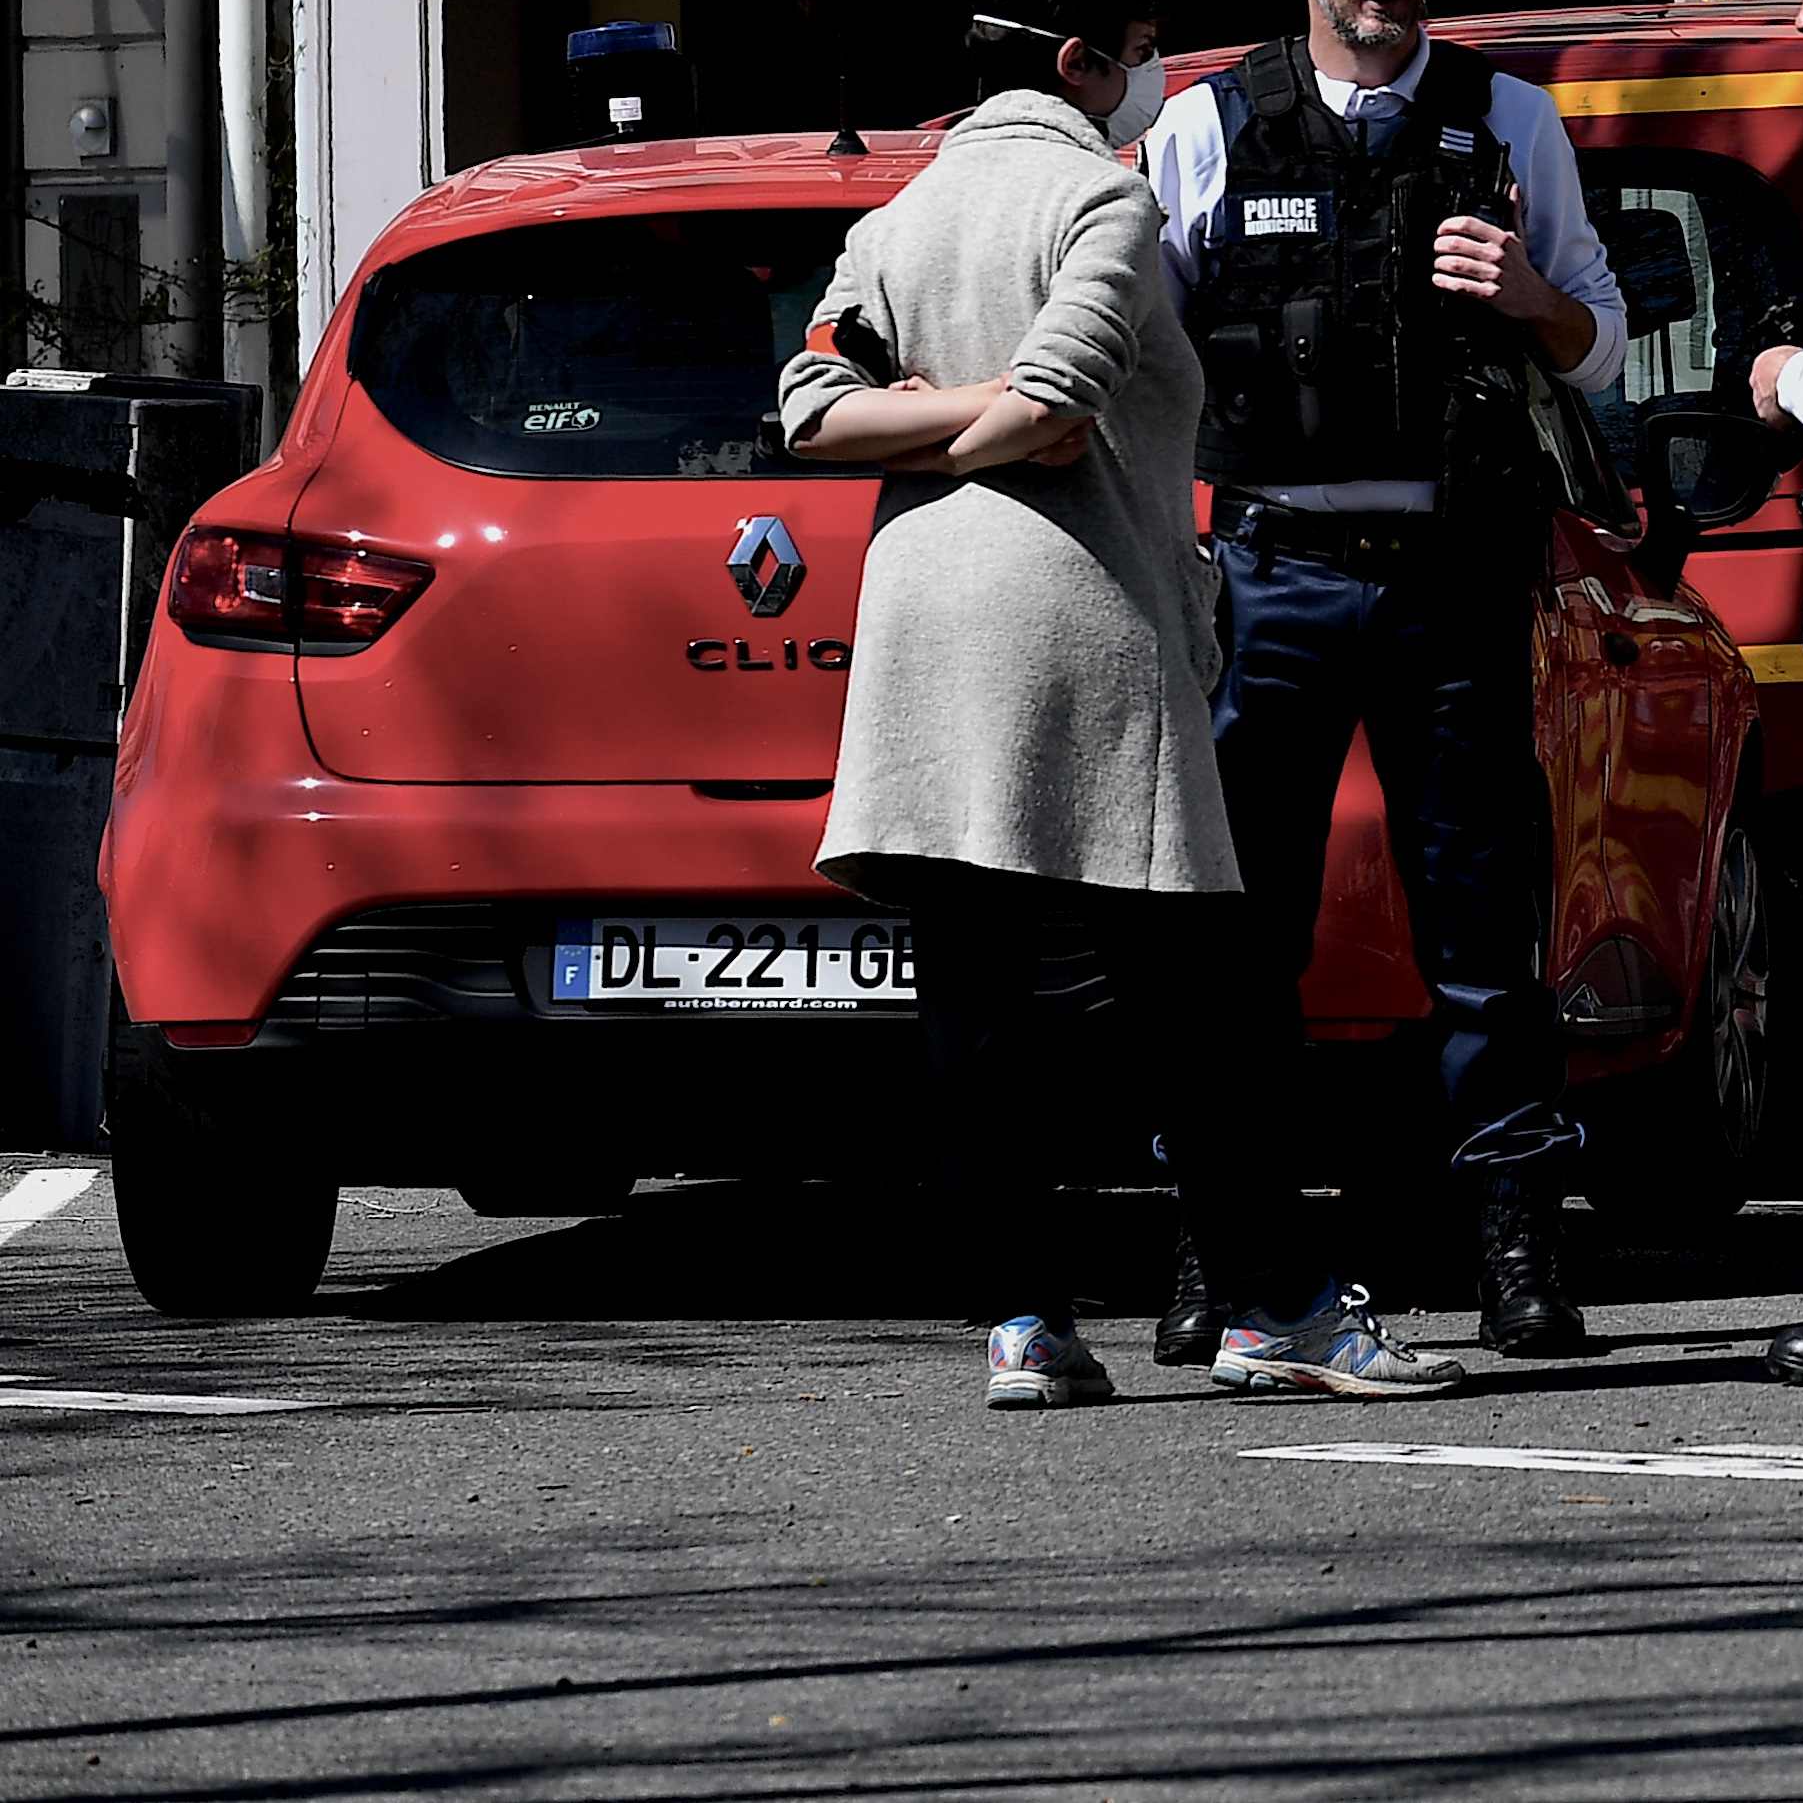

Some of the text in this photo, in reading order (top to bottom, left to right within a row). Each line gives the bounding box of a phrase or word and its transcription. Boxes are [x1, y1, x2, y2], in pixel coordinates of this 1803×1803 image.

[1243, 197, 1318, 222] POLICE
[685, 637, 852, 671] CLIO
[664, 998, 857, 1010] autobernard.com
